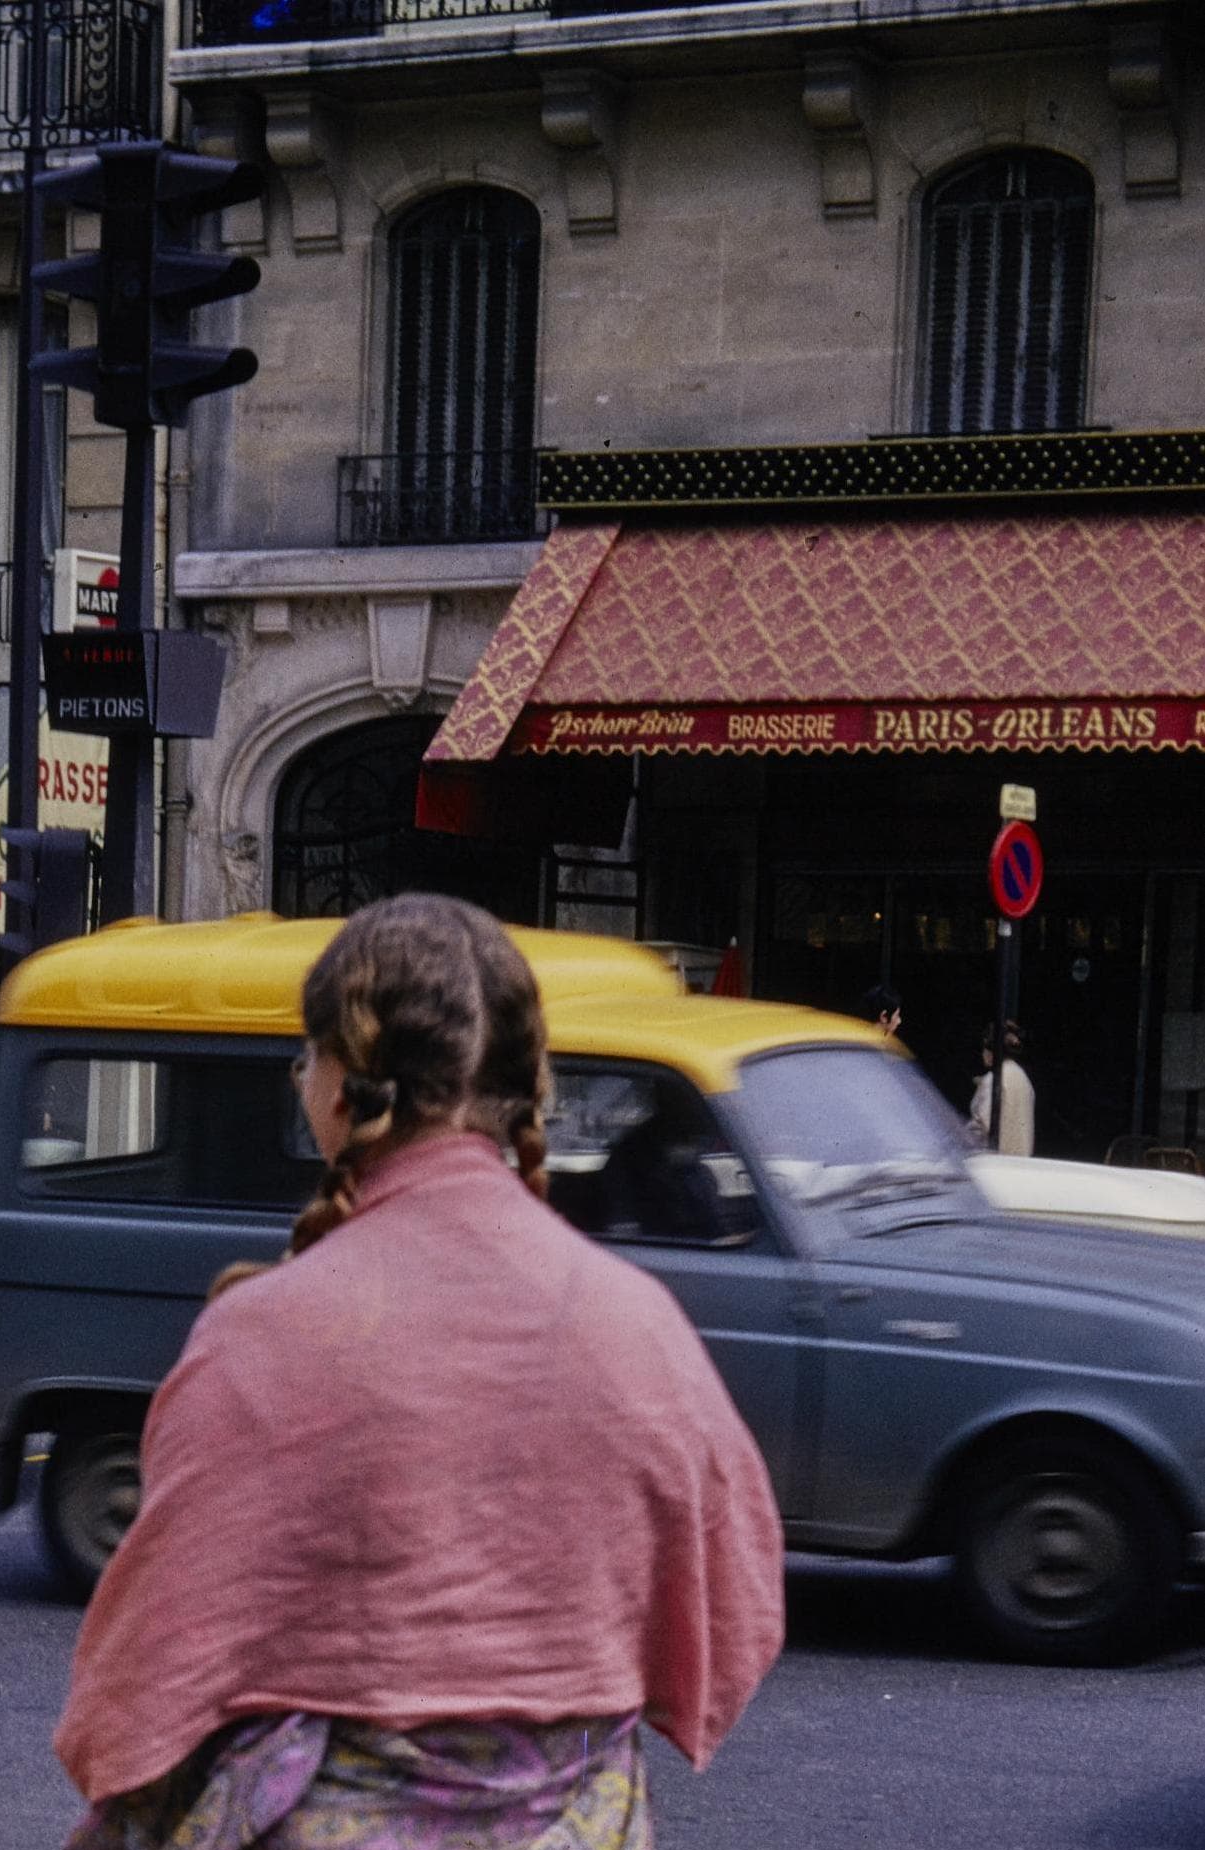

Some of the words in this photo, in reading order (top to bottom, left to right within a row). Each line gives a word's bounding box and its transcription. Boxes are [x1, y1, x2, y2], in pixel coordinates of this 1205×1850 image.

[78, 588, 119, 614] MART
[59, 698, 144, 718] PIETONS
[728, 714, 835, 739] BRASSERIE
[874, 707, 1157, 740] PARIS-ORLEANS
[38, 758, 109, 806] RASSE
